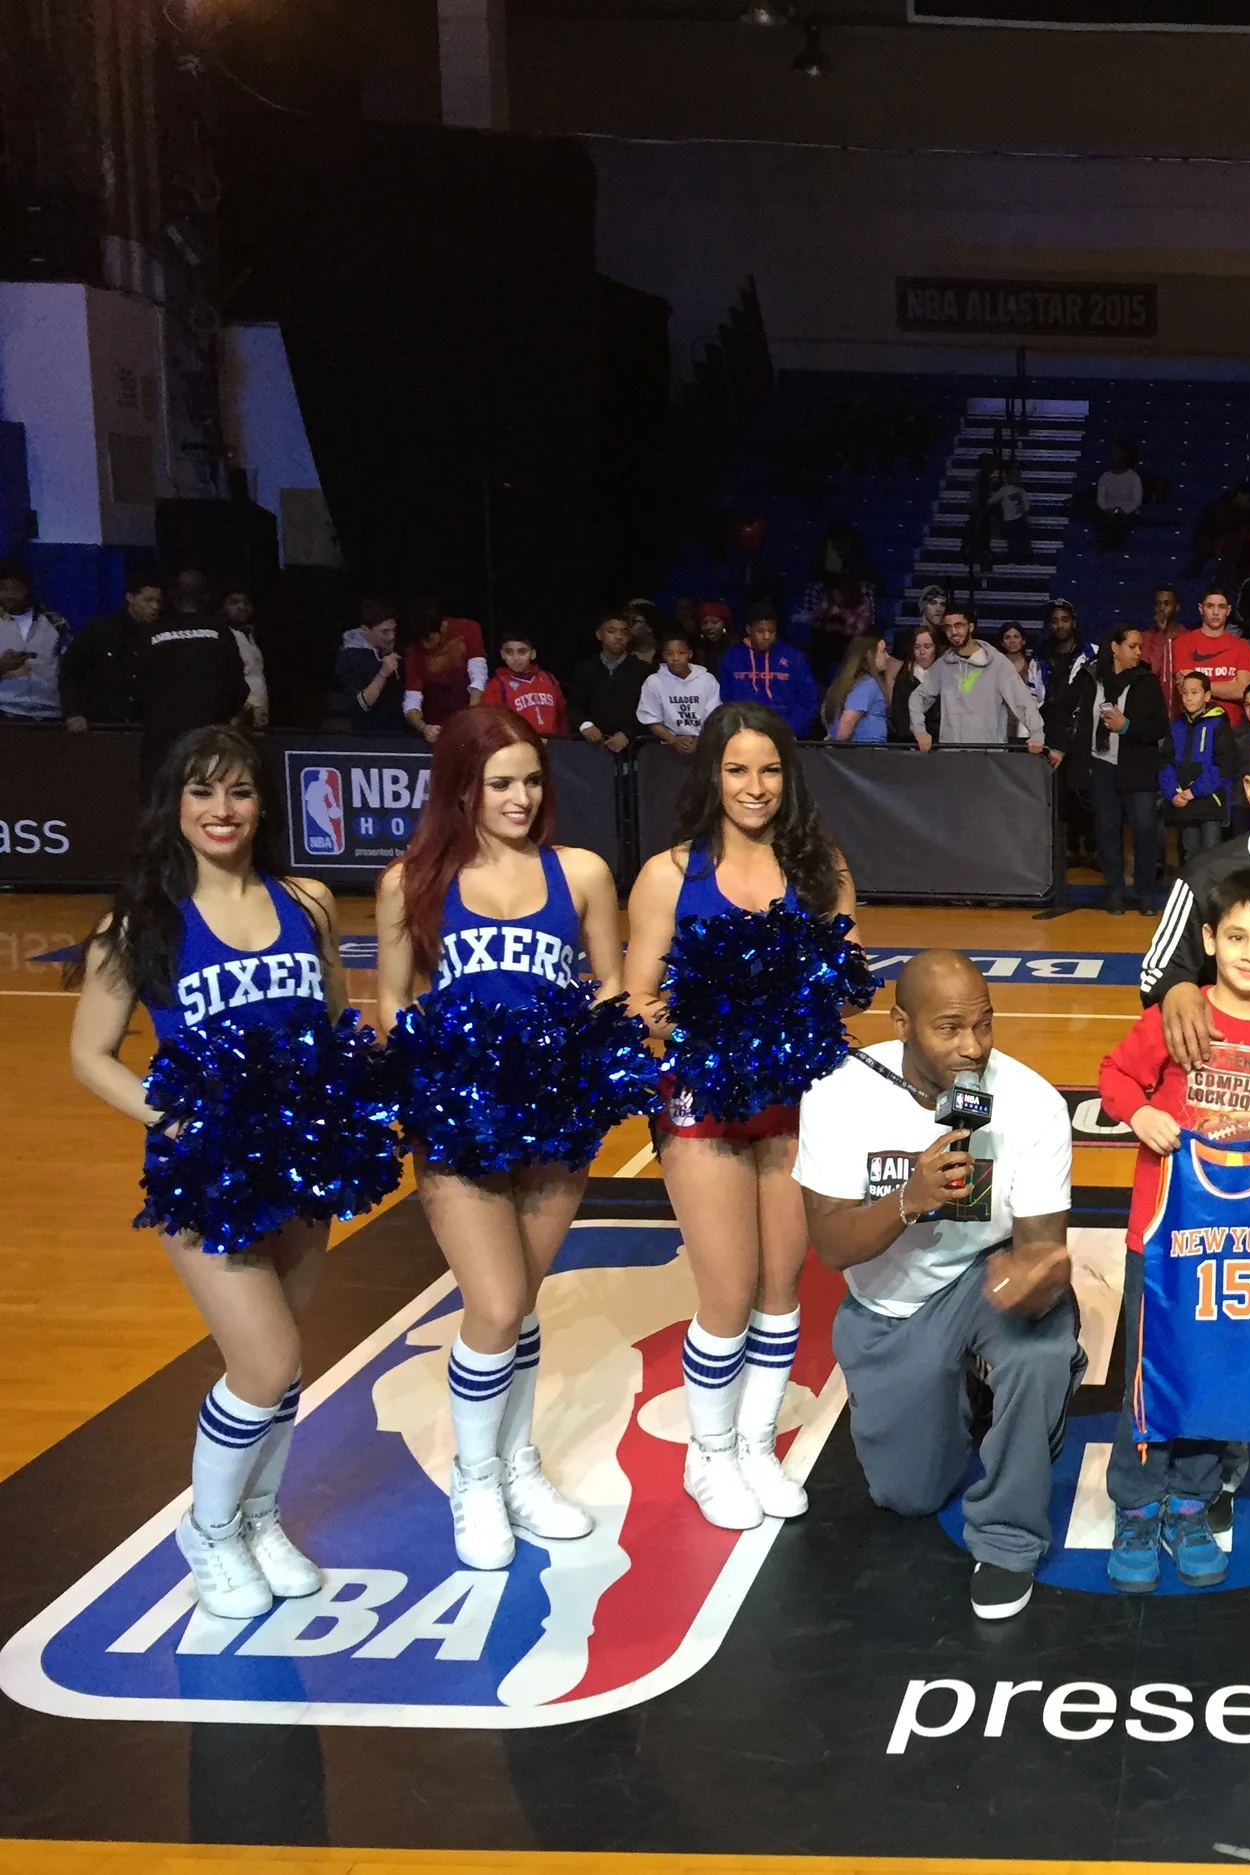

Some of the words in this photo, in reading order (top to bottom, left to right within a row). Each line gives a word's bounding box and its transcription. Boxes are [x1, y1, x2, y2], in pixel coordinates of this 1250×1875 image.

[906, 288, 959, 321] NBA
[1089, 294, 1147, 327] 2015
[1215, 666, 1227, 677] DO
[514, 692, 554, 712] SIXERS
[668, 695, 700, 705] LEADER
[676, 719, 702, 728] PACK
[678, 711, 698, 720] THE
[350, 767, 432, 809] NBA
[176, 952, 324, 1027] SIXER
[1170, 1227, 1229, 1257] NEW
